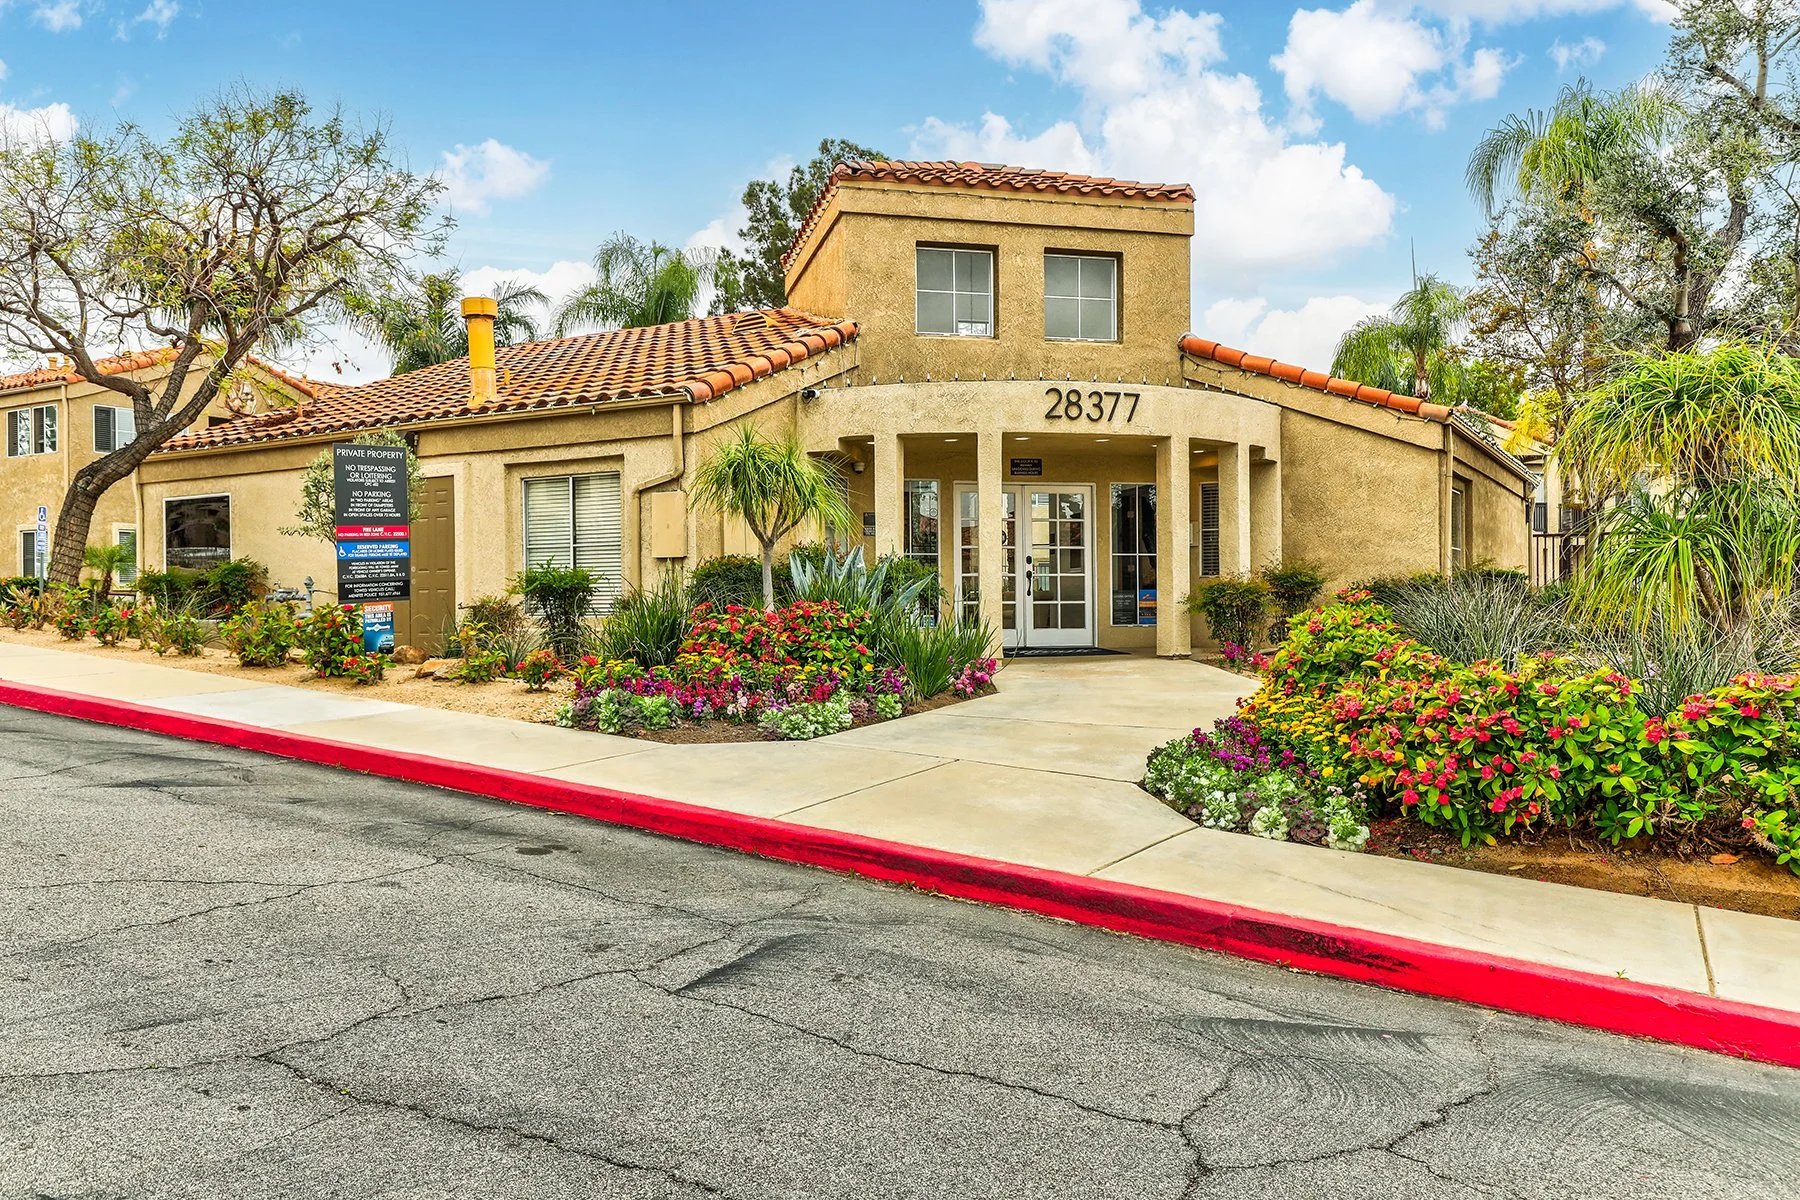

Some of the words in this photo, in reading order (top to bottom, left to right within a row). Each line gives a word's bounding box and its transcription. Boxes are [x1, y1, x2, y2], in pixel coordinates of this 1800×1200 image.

[1045, 388, 1140, 423] 28377
[337, 449, 365, 457] PRIVATE
[367, 450, 403, 459] PROPERTY
